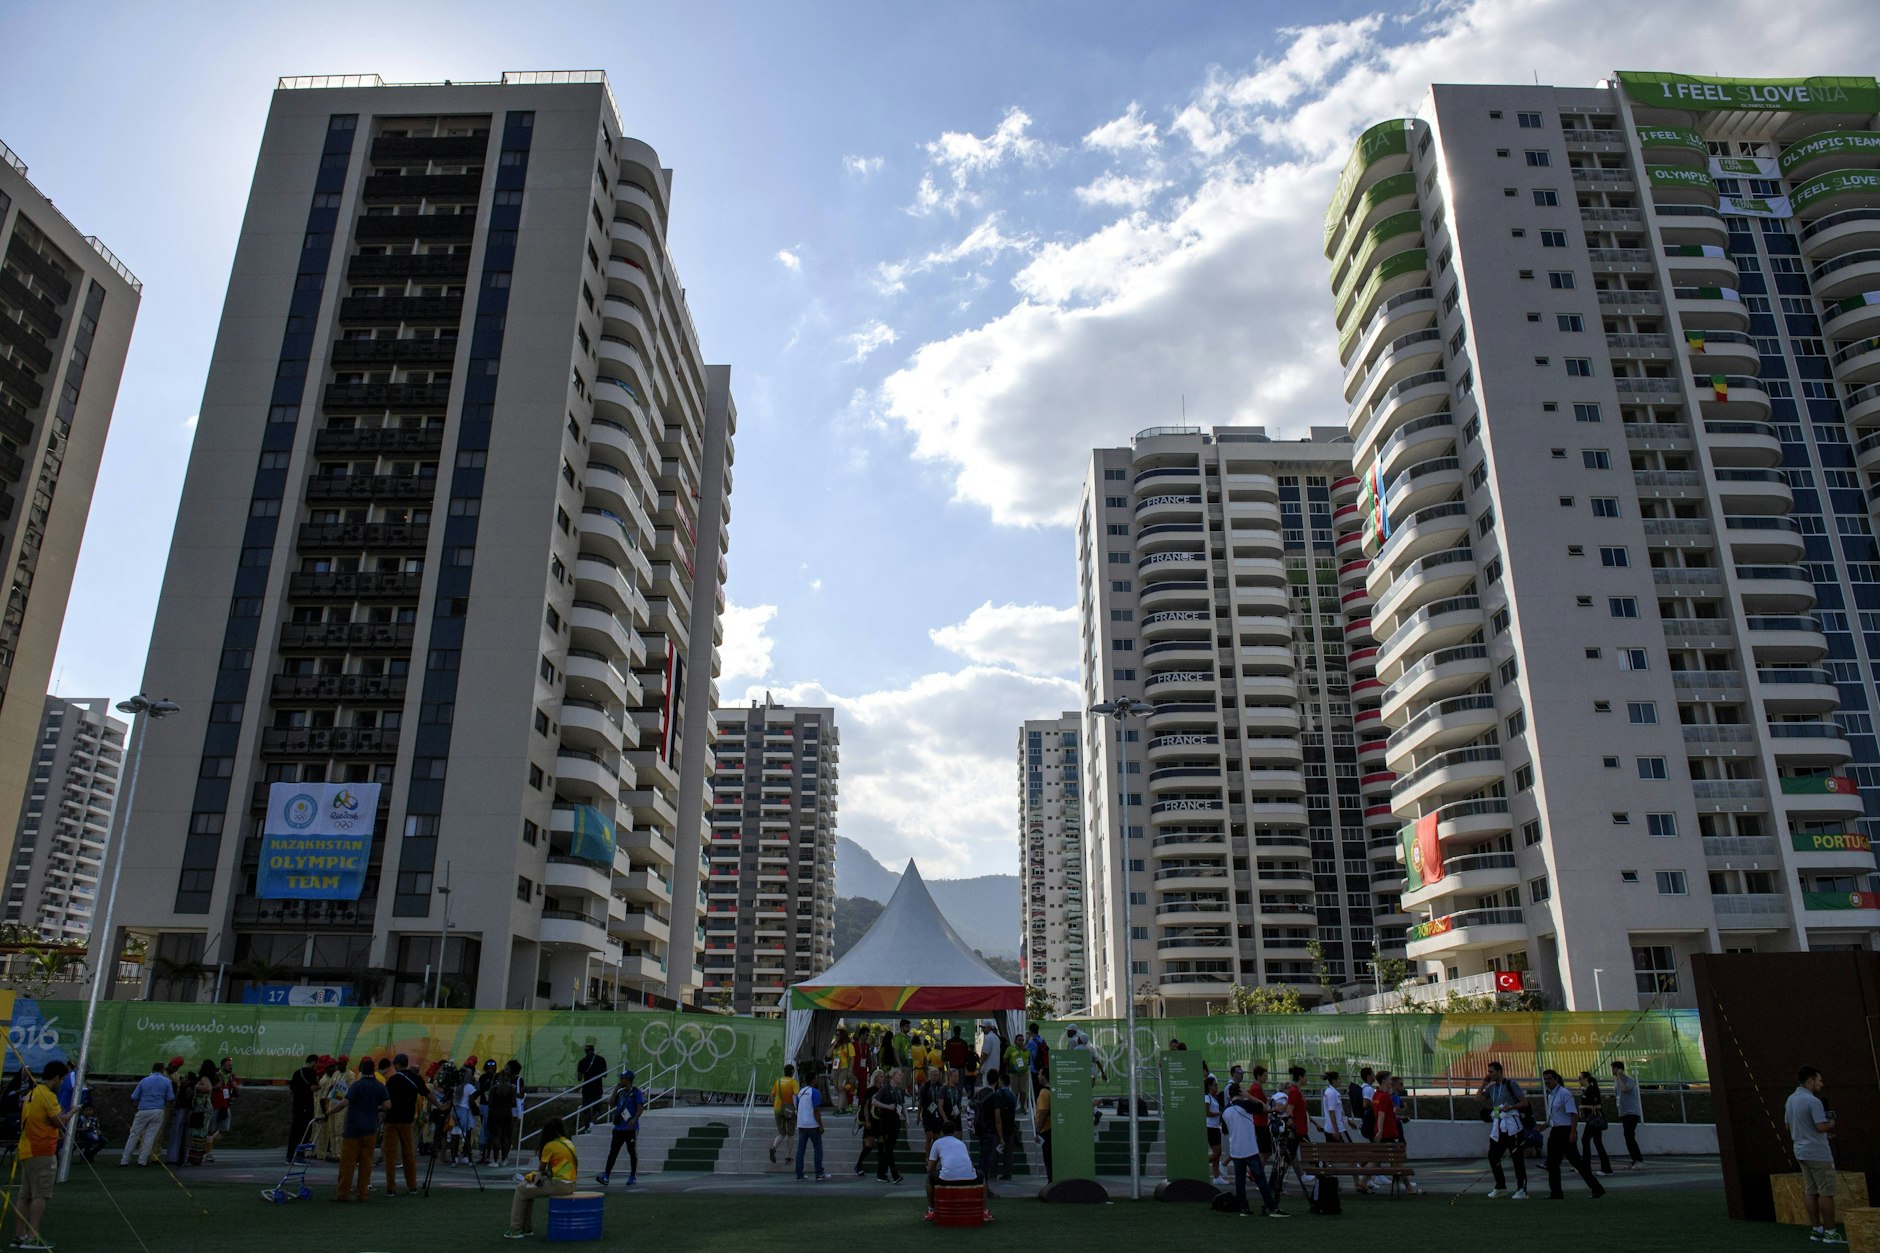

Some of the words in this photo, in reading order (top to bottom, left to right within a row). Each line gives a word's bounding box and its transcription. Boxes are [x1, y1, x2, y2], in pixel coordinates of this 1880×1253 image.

[1661, 83, 1673, 98] I
[1676, 84, 1732, 101] FEEL
[1736, 85, 1849, 102] SLOVENIA
[1640, 131, 1648, 142] I
[1649, 131, 1681, 140] FEEL
[1783, 137, 1844, 167] OLYMPIC
[1845, 136, 1880, 147] TEAM
[1655, 170, 1710, 184] OLYMPIC
[1790, 198, 1797, 209] I
[1797, 182, 1830, 203] FEEL
[1146, 495, 1190, 507] FRANCE
[1154, 611, 1199, 623] FRANCE
[1157, 673, 1203, 684] FRANCE
[1161, 736, 1208, 747] FRANCE
[1164, 801, 1212, 811] FRANCE
[271, 840, 363, 850] KAZAKHSTAN
[270, 856, 359, 868] OLYMPIC
[288, 875, 340, 889] TEAM
[268, 990, 285, 1002] 17
[137, 1016, 165, 1031] Um
[169, 1018, 225, 1034] mundo
[227, 1024, 266, 1035] novo
[7, 1016, 59, 1050] 016
[1207, 1030, 1235, 1046] Um
[1571, 1031, 1586, 1045] de
[218, 1041, 229, 1055] A
[231, 1045, 264, 1056] new
[266, 1043, 305, 1057] world
